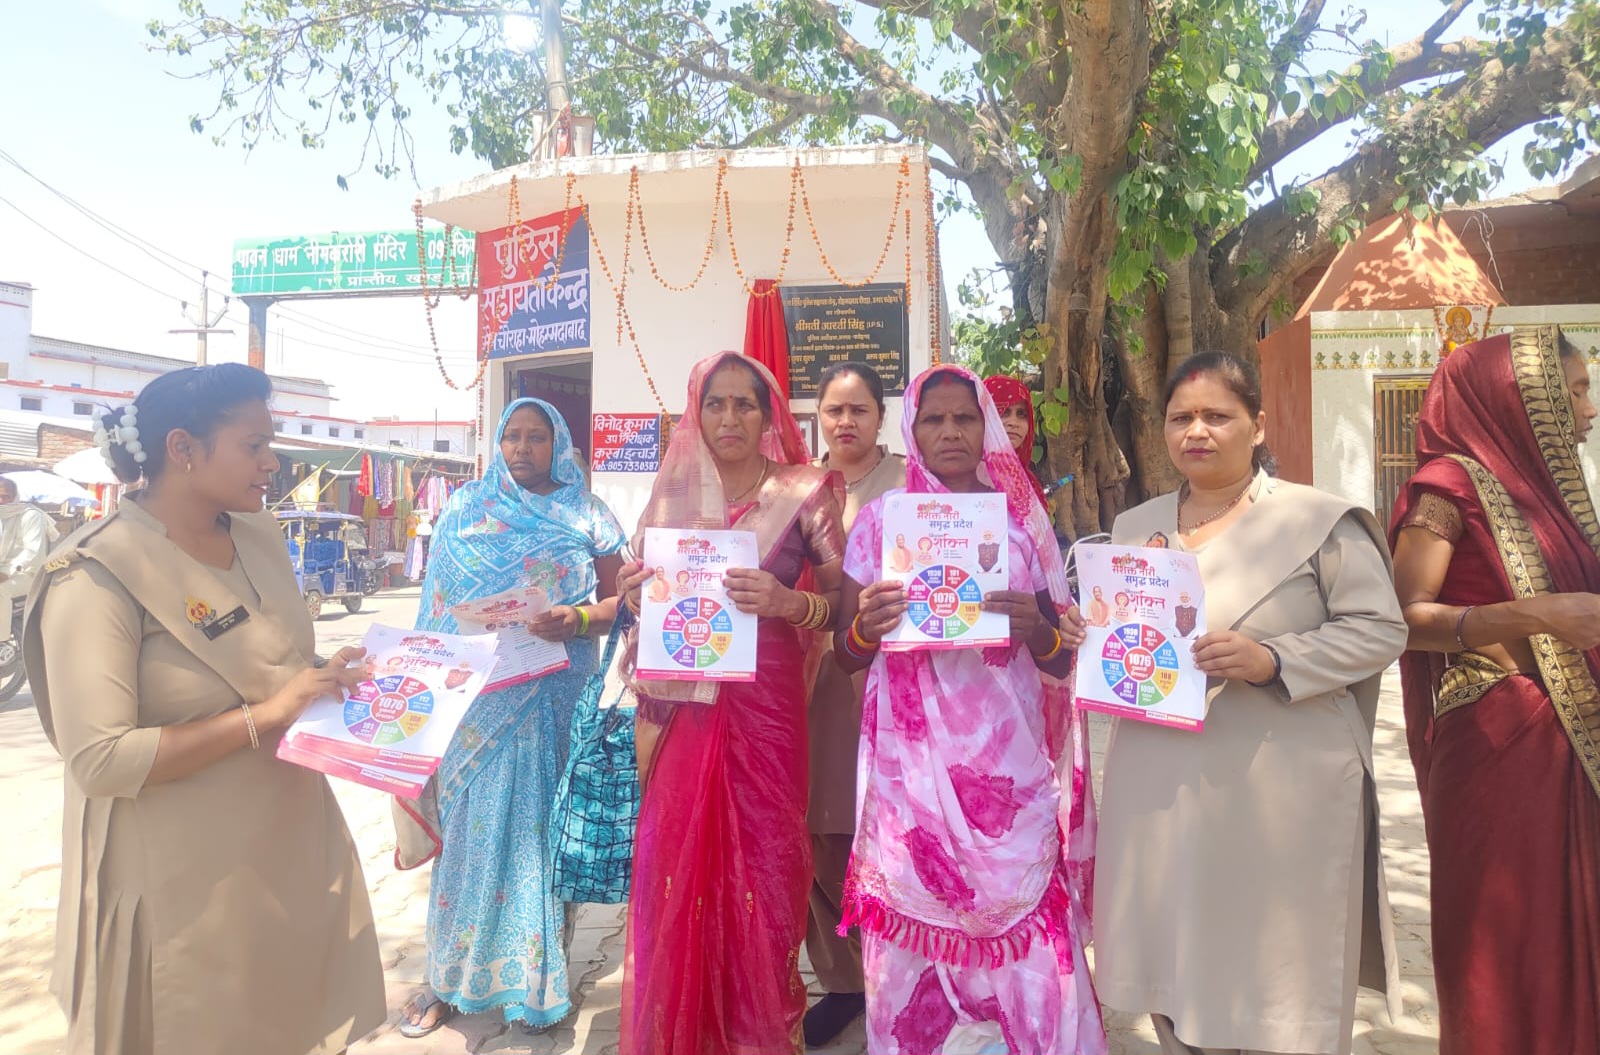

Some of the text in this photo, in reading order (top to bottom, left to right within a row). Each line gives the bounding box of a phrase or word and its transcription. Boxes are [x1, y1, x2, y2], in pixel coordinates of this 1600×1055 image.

[274, 246, 298, 266] धाम
[374, 235, 406, 262] मंदिर
[428, 240, 444, 260] 09
[494, 225, 560, 279] पुलिस
[480, 262, 589, 324] सहायता केन्द्र
[795, 318, 820, 332] श्रीमती
[821, 318, 846, 330] आरती
[848, 318, 865, 330] सिंह
[594, 414, 656, 434] विनोद कुमार
[605, 432, 654, 446] उप निरीक्षक
[1124, 576, 1169, 588] समृद्ध प्रदेश
[933, 592, 955, 604] 1076
[688, 623, 708, 633] 1076
[1128, 653, 1152, 668] 1076
[379, 697, 404, 710] 1076
